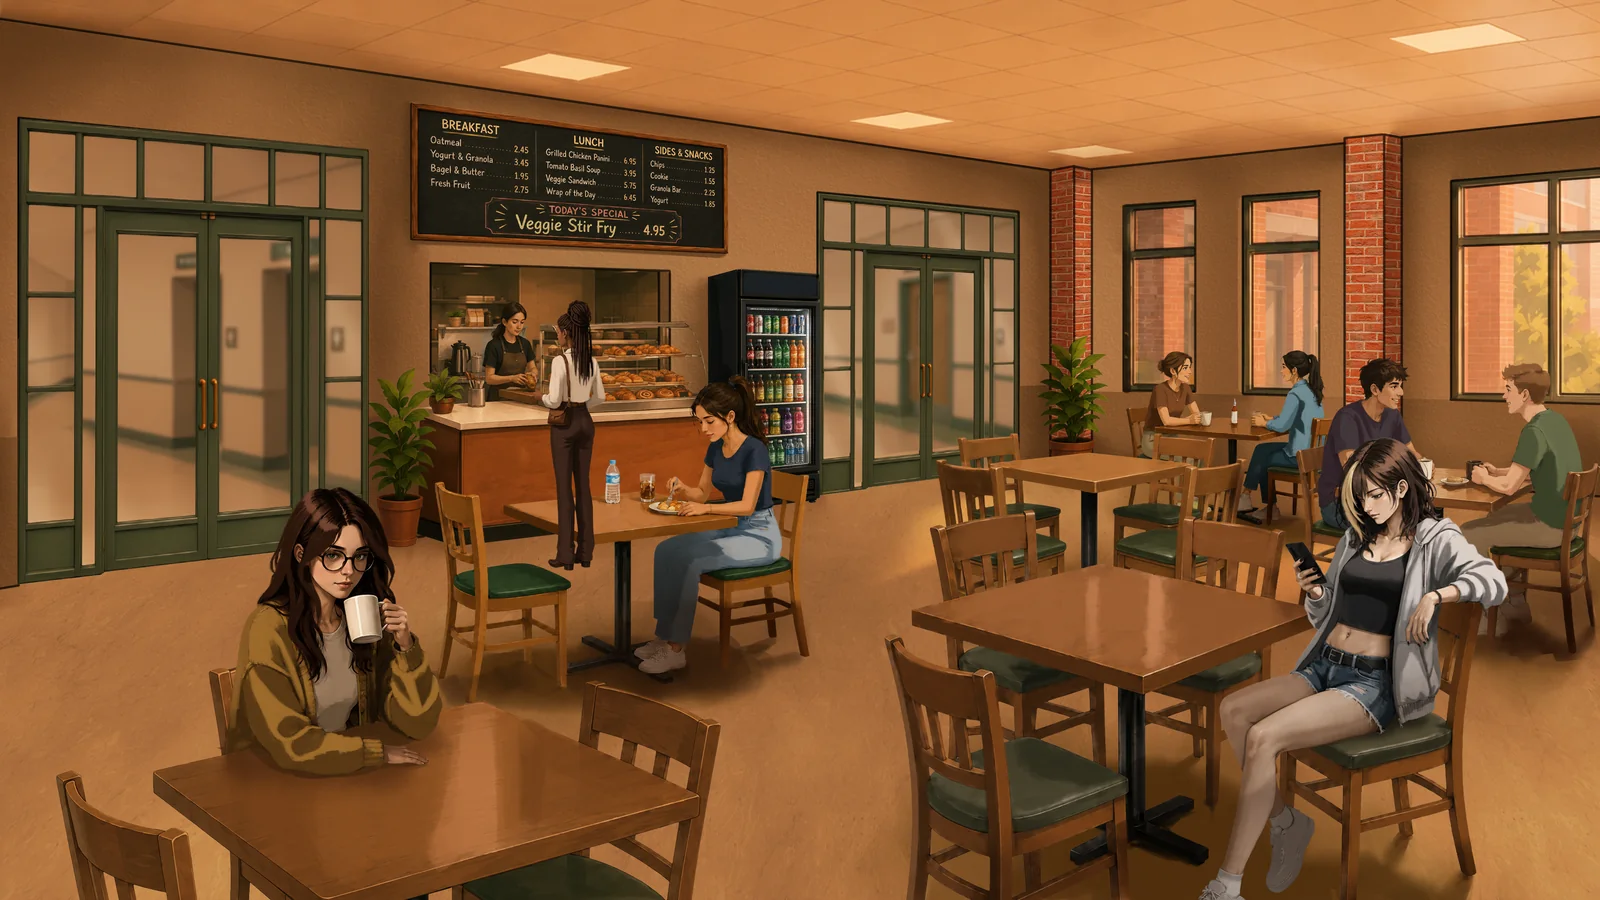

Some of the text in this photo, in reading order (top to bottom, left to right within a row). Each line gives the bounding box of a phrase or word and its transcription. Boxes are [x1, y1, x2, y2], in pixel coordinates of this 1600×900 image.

[442, 119, 500, 135] BREAKFAST
[430, 136, 529, 154] Oatmeal 2.45
[574, 135, 604, 147] LUNCH
[430, 149, 455, 160] Yogurt
[466, 155, 493, 163] Granola
[546, 149, 566, 158] Grilled
[569, 151, 592, 160] Chicken
[594, 154, 610, 162] Panini
[655, 146, 676, 156] SIDES
[685, 150, 712, 160] SNACKS
[431, 164, 451, 175] Bagel
[462, 167, 485, 176] Butter
[546, 161, 568, 170] Tomato
[570, 164, 584, 172] Basil
[587, 166, 600, 175] Soup
[650, 160, 665, 169] Chips
[430, 178, 450, 187] Fresh
[546, 174, 566, 184] Veggie
[568, 176, 596, 185] Sandwich
[650, 172, 668, 180] Cookie
[546, 187, 563, 197] Wrap
[585, 191, 596, 200] Day
[650, 184, 671, 192] Granola
[650, 196, 668, 205] Yogurt
[549, 205, 628, 219] TODAY'S SPECIAL
[516, 214, 665, 238] Veggie Stir Fry 4.95
